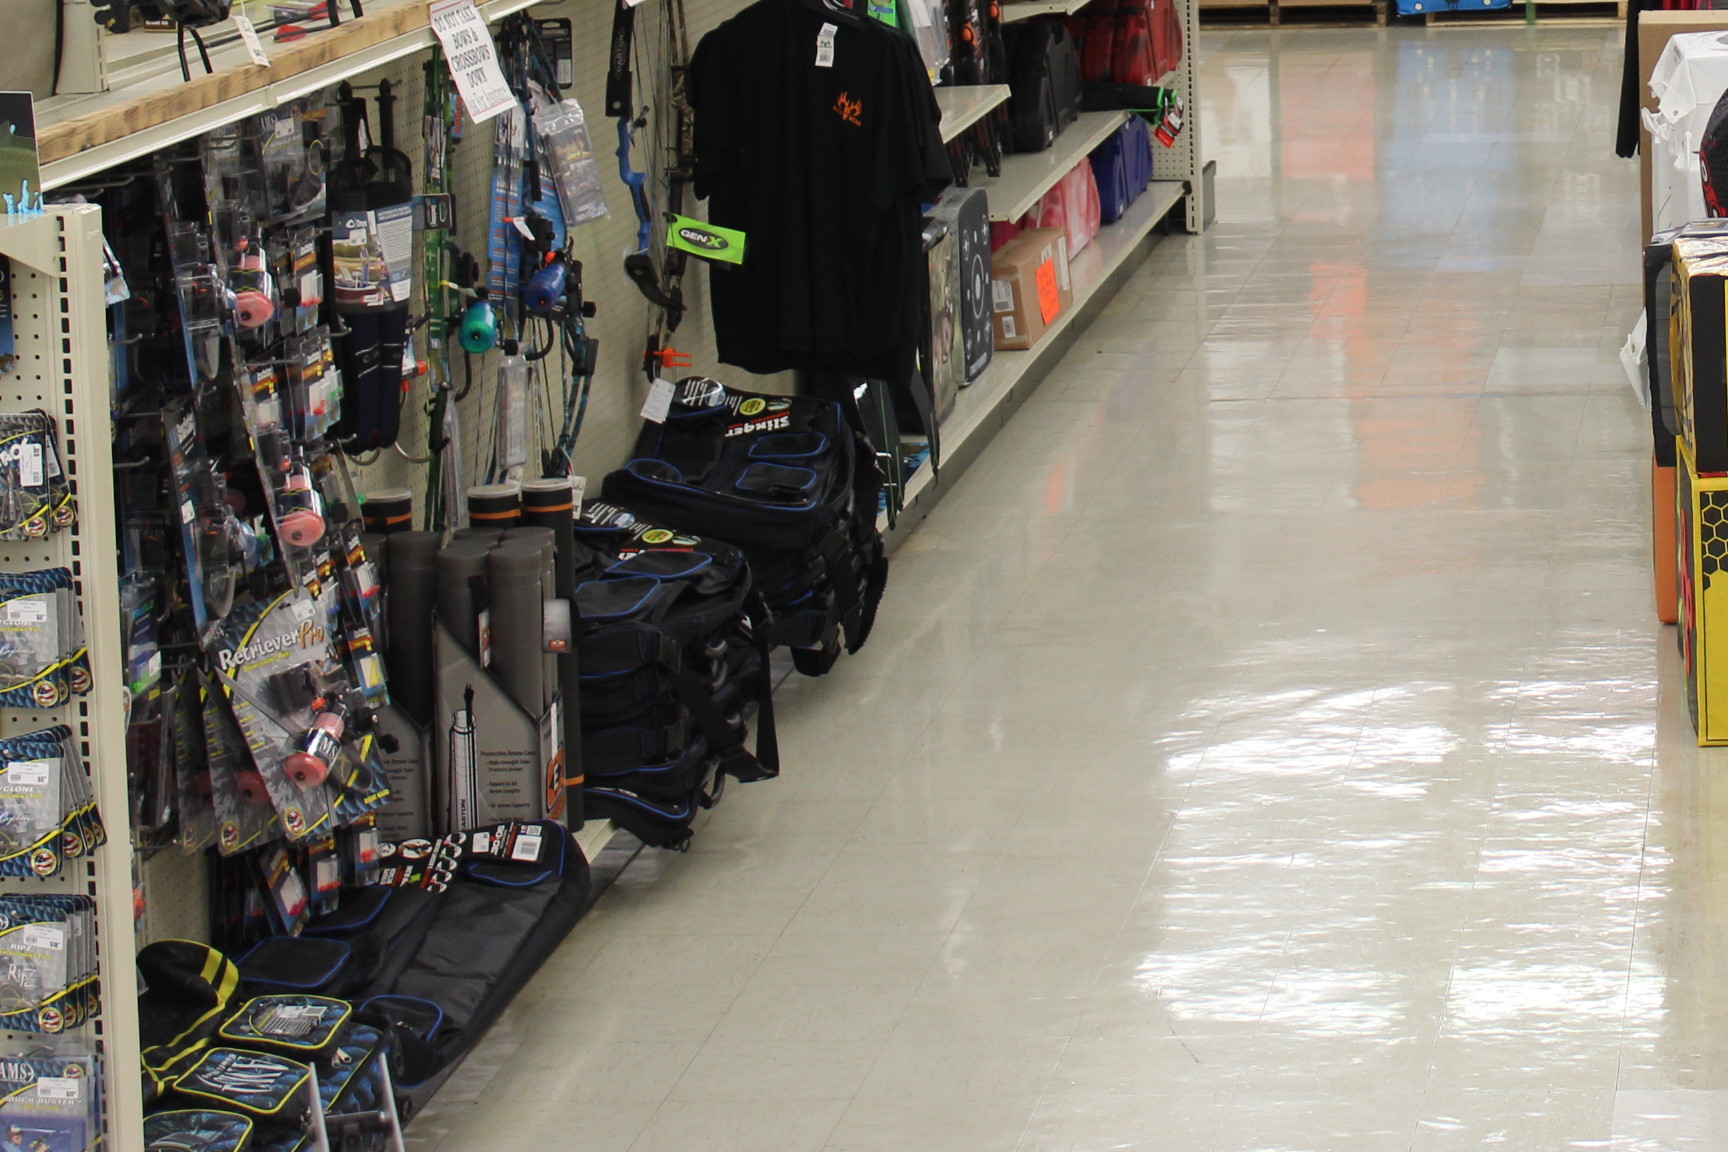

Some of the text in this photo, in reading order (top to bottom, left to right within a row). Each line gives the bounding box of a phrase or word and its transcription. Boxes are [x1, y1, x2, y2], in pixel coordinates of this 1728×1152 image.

[433, 16, 445, 33] DO
[444, 9, 461, 30] NOT
[451, 26, 479, 50] BOWS &
[450, 43, 491, 73] CROSSBOWS
[465, 67, 488, 89] DOWN
[725, 415, 790, 438] Slinger
[0, 618, 32, 626] YCLONE
[318, 735, 340, 756] MS
[0, 785, 34, 793] YCLONE
